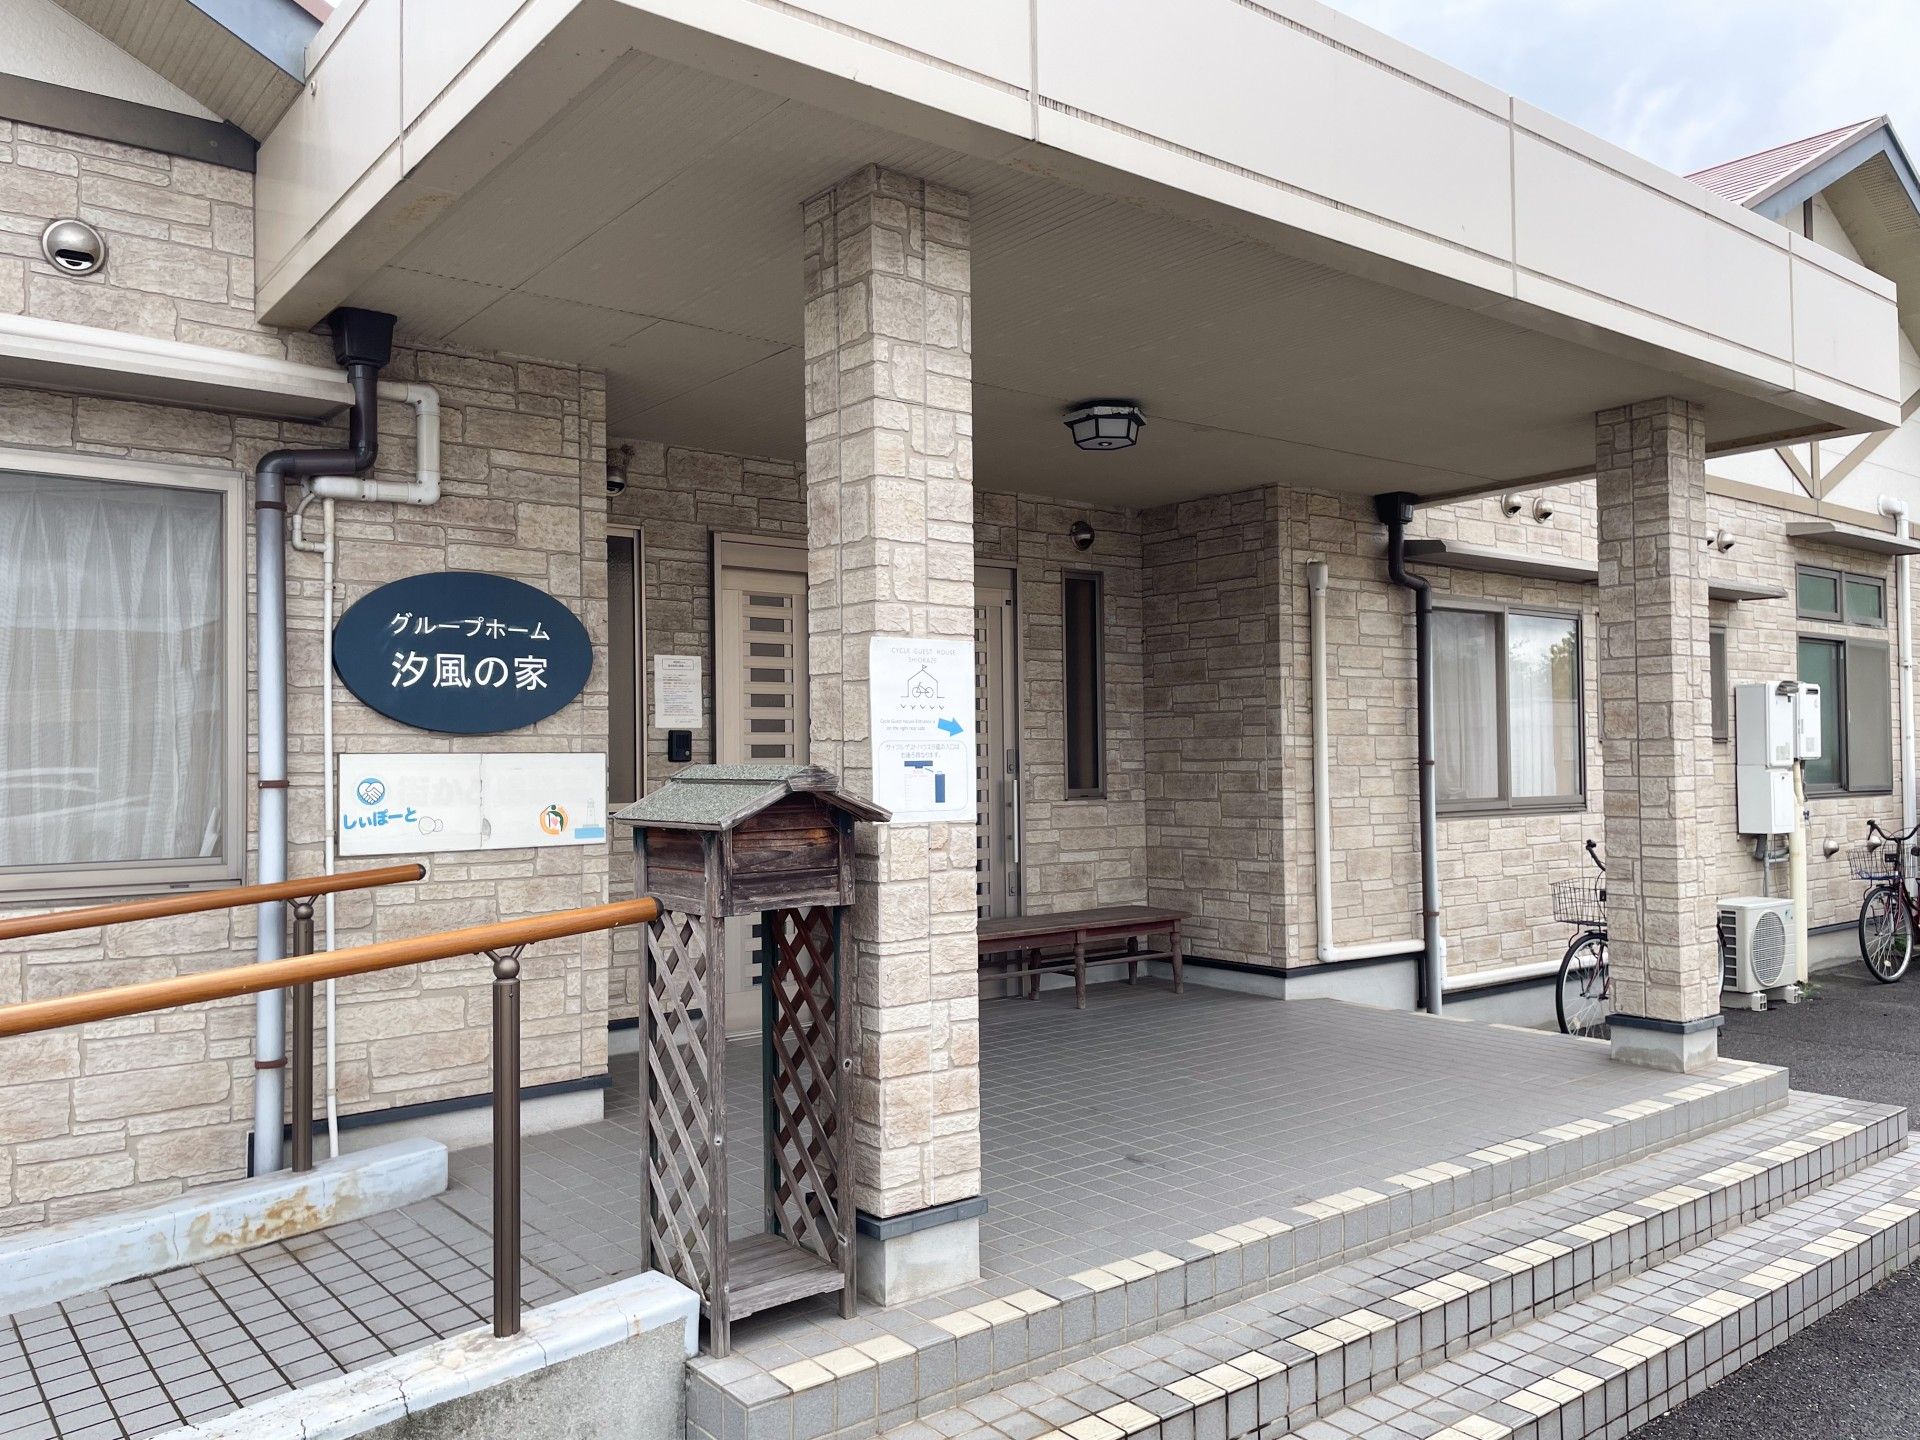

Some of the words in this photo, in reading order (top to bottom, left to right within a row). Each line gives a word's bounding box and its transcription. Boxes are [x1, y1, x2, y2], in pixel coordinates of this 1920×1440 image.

[390, 611, 551, 641] グループホーム
[391, 651, 549, 691] 汐風の家
[343, 806, 418, 830] しいぽーと
